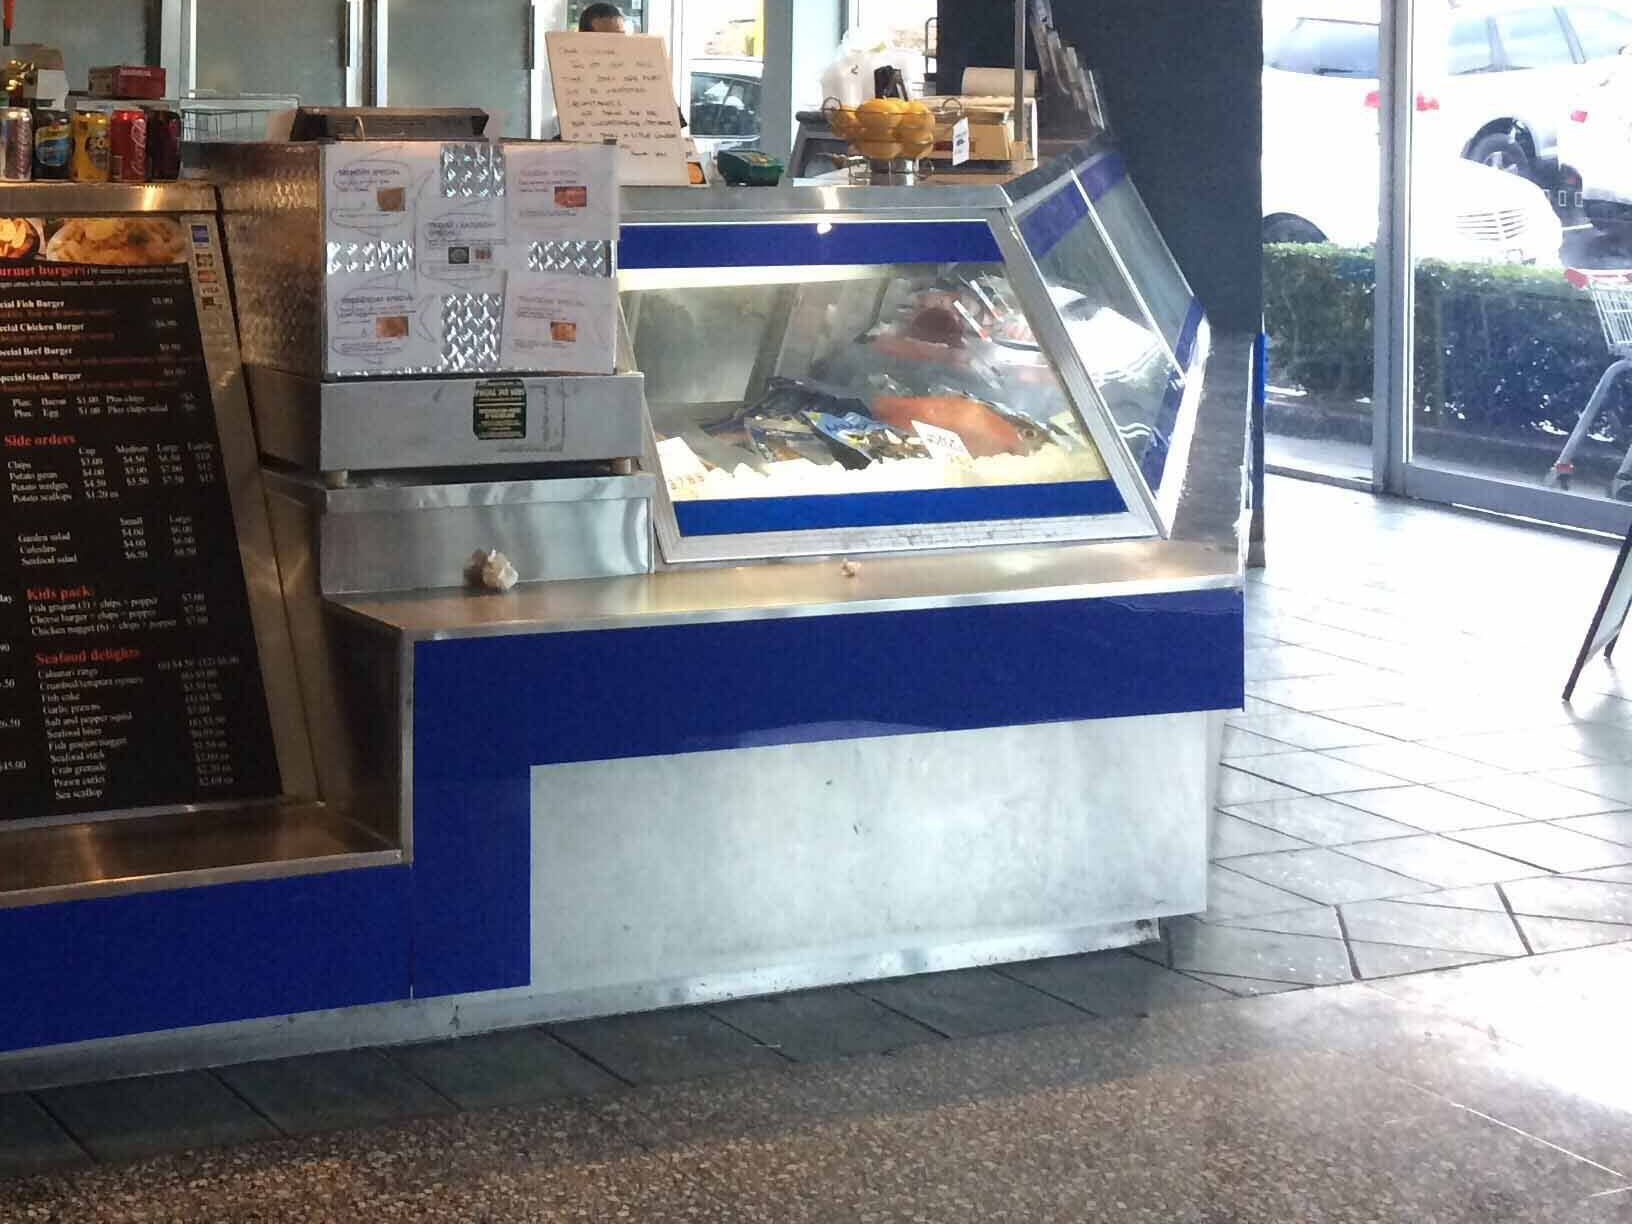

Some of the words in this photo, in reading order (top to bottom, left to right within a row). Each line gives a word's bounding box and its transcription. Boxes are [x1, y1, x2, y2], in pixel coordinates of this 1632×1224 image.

[16, 299, 35, 309] Fish
[36, 298, 65, 309] Burger
[20, 322, 55, 332] Chicken
[56, 321, 84, 333] Burger
[23, 346, 42, 356] Beef
[44, 346, 72, 357] Burger
[27, 372, 52, 381] Steak
[53, 371, 82, 382] Burger
[4, 434, 34, 447] Side
[36, 434, 76, 446] orders
[34, 650, 87, 664] Seafood
